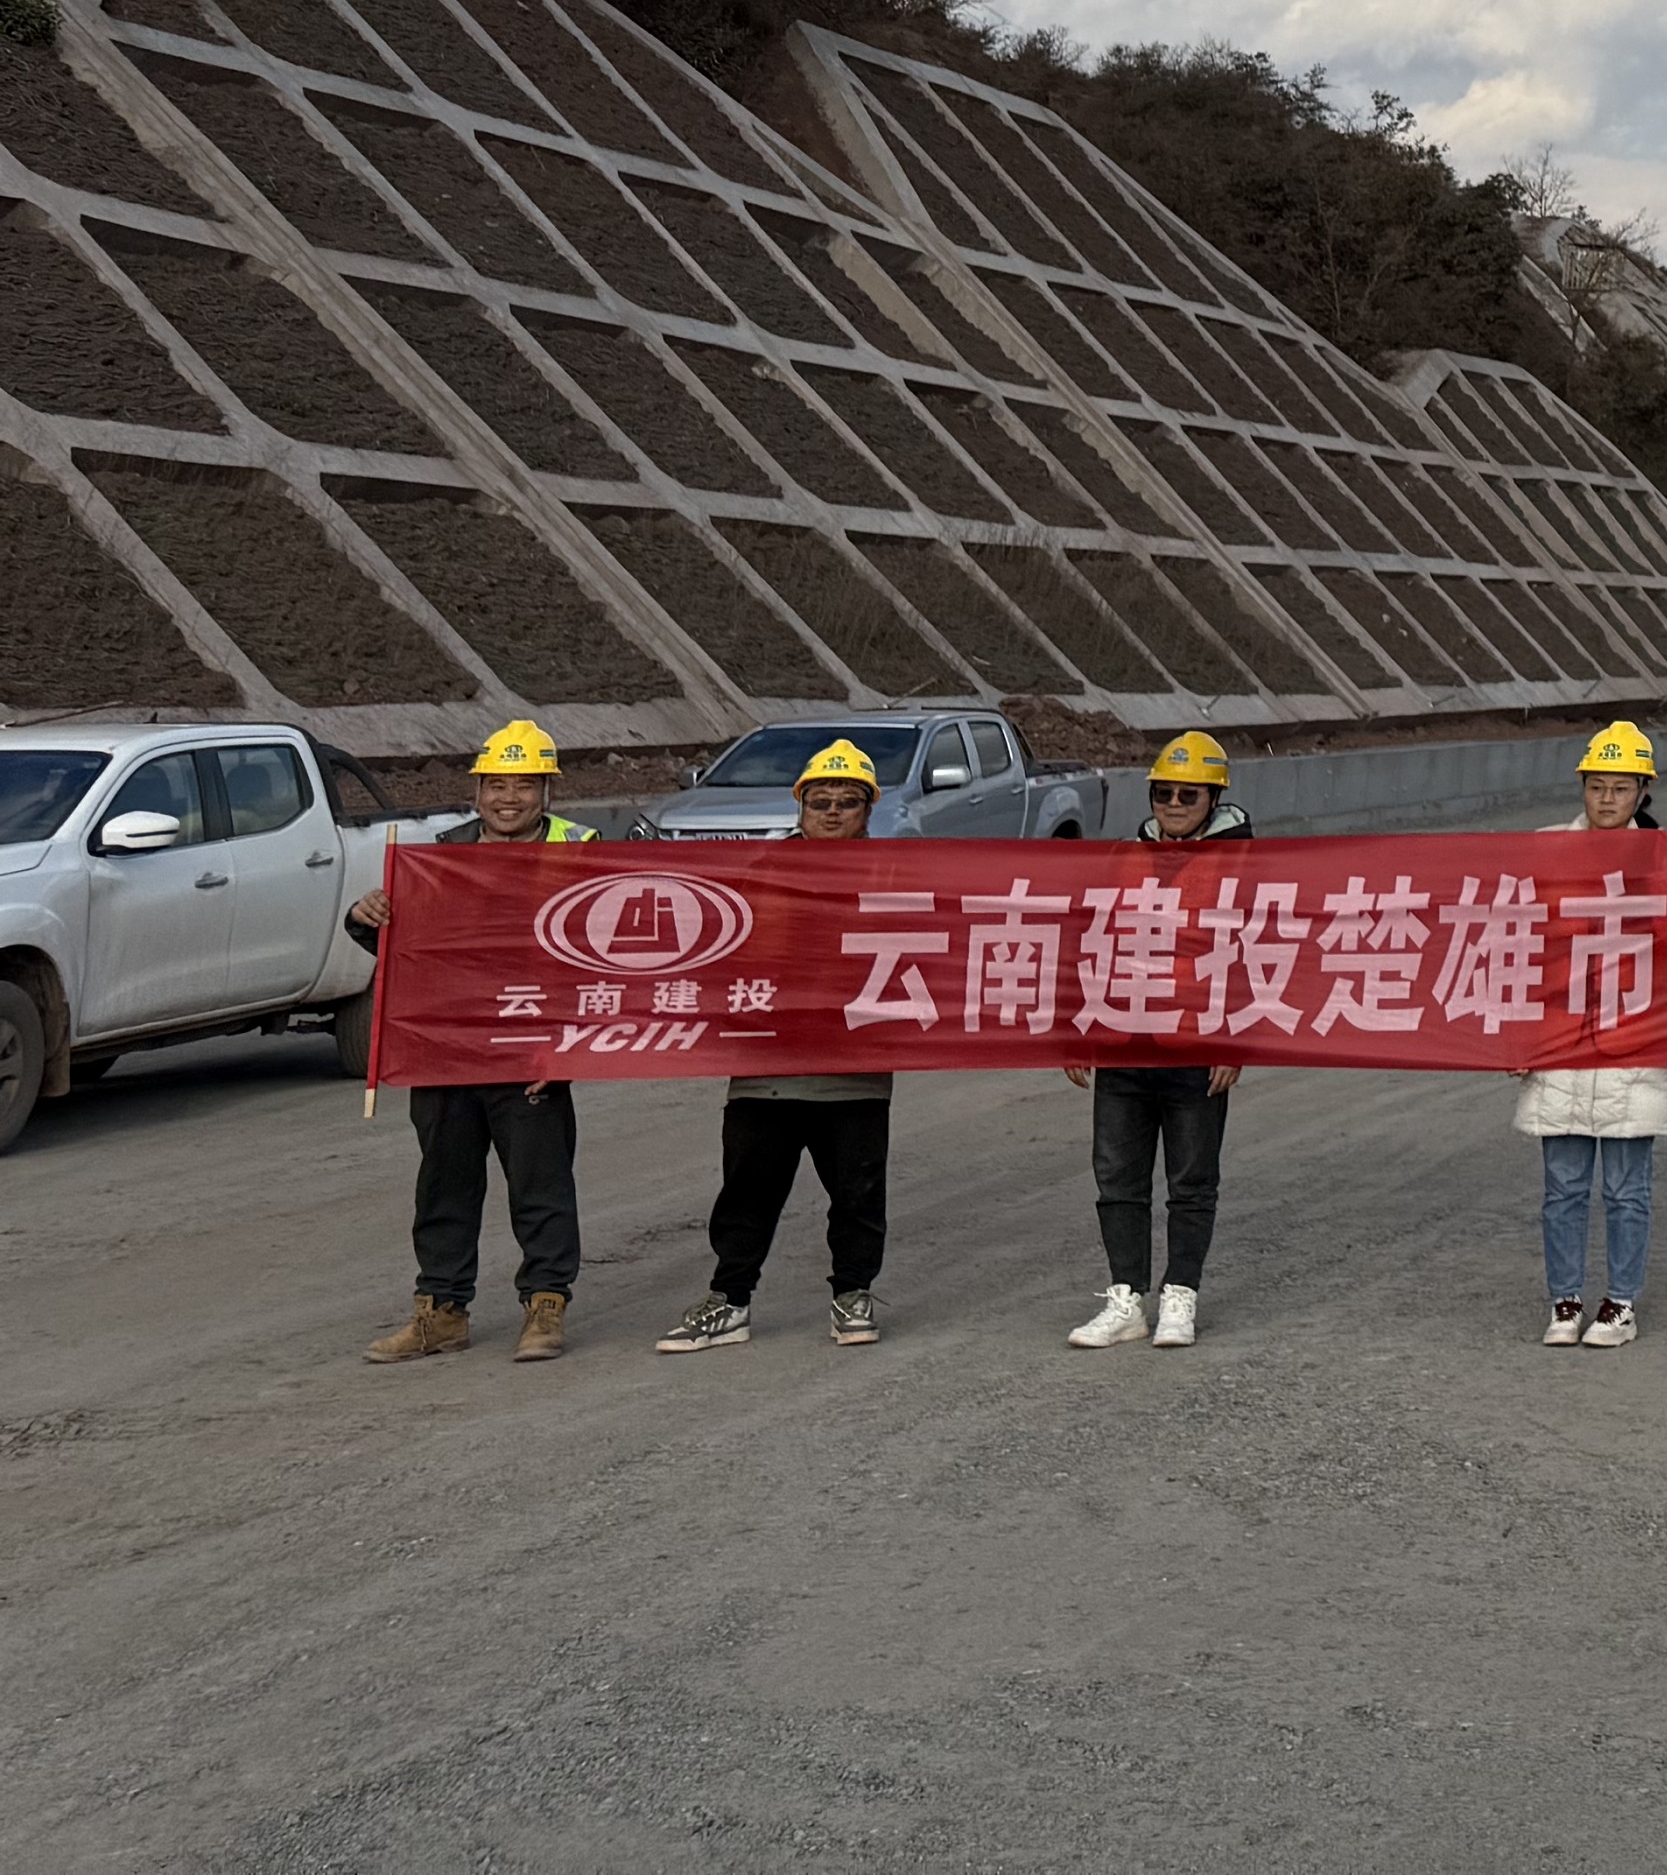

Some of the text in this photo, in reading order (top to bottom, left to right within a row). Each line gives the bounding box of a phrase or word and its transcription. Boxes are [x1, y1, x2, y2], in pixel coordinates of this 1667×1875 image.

[496, 977, 778, 1018] 云南建投
[554, 1021, 709, 1053] YCIH
